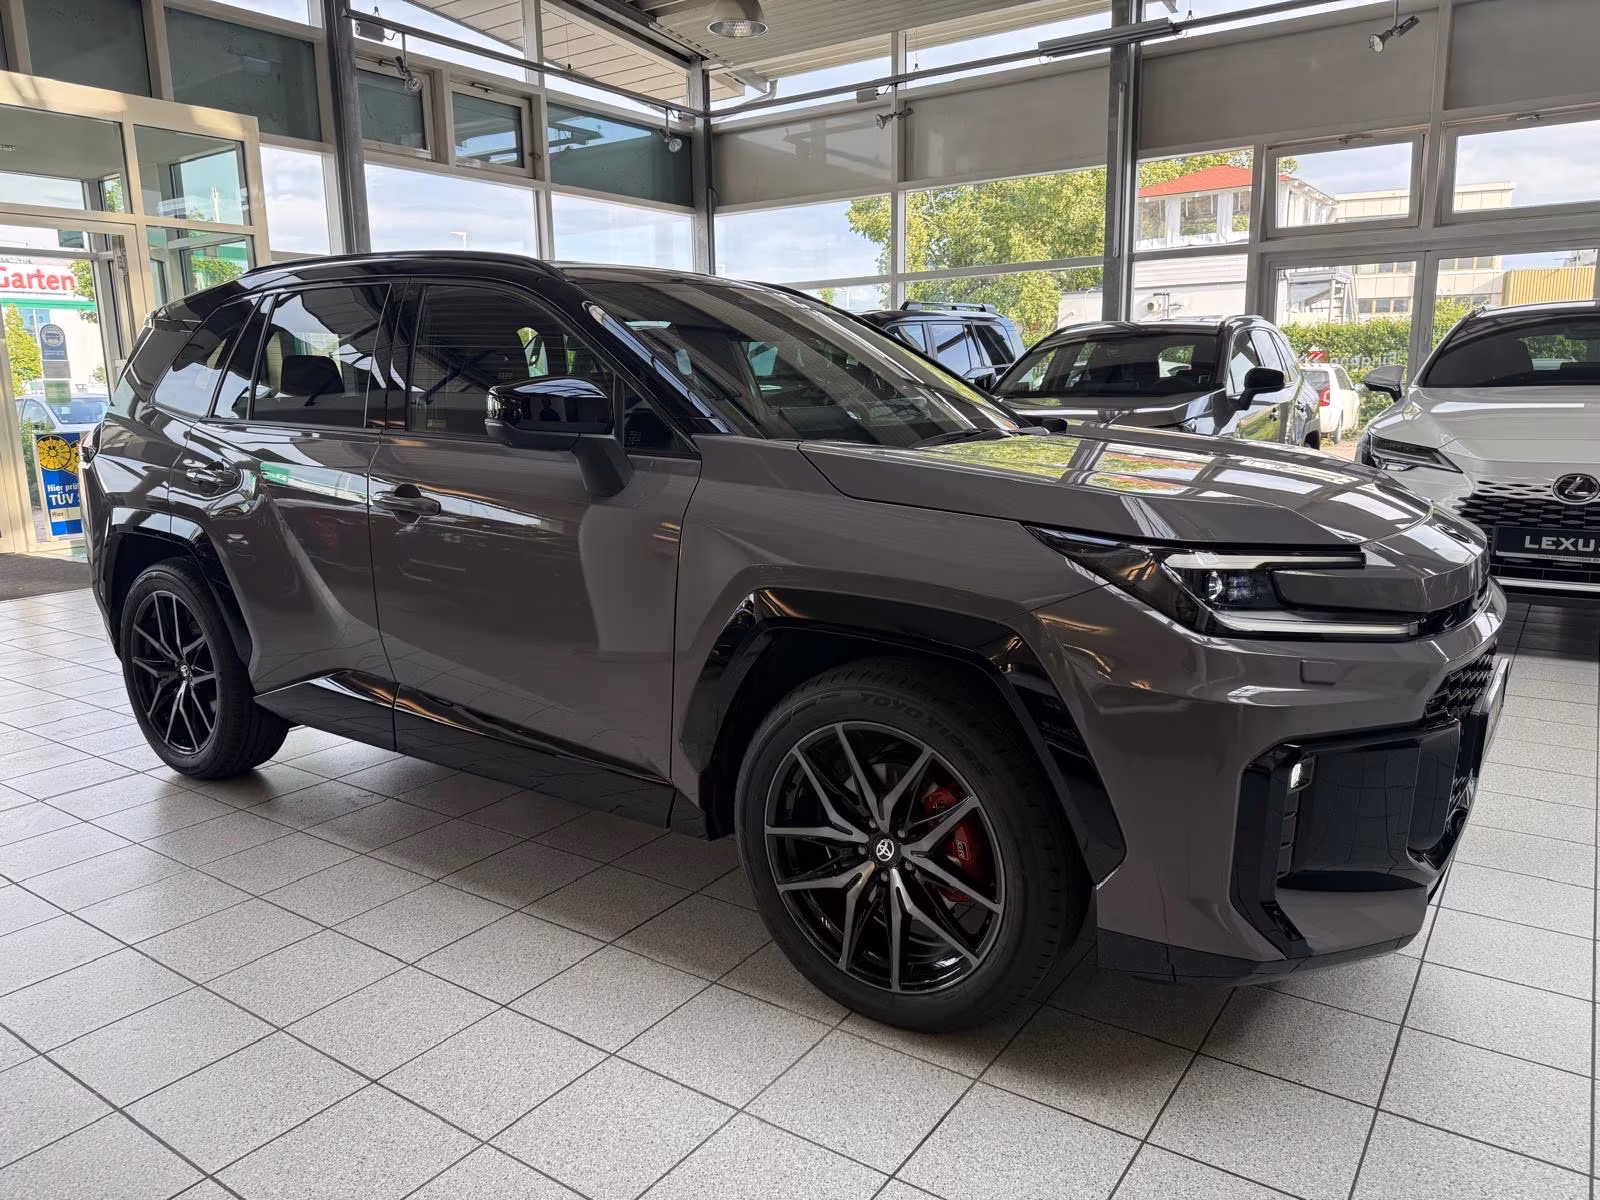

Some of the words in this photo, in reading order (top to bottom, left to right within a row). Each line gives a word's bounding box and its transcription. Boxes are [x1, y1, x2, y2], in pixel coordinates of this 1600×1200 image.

[0, 266, 75, 291] Garten
[47, 484, 63, 492] Hier
[48, 491, 74, 506] TÜV
[1524, 535, 1600, 552] LEXU
[859, 692, 924, 720] TOYO
